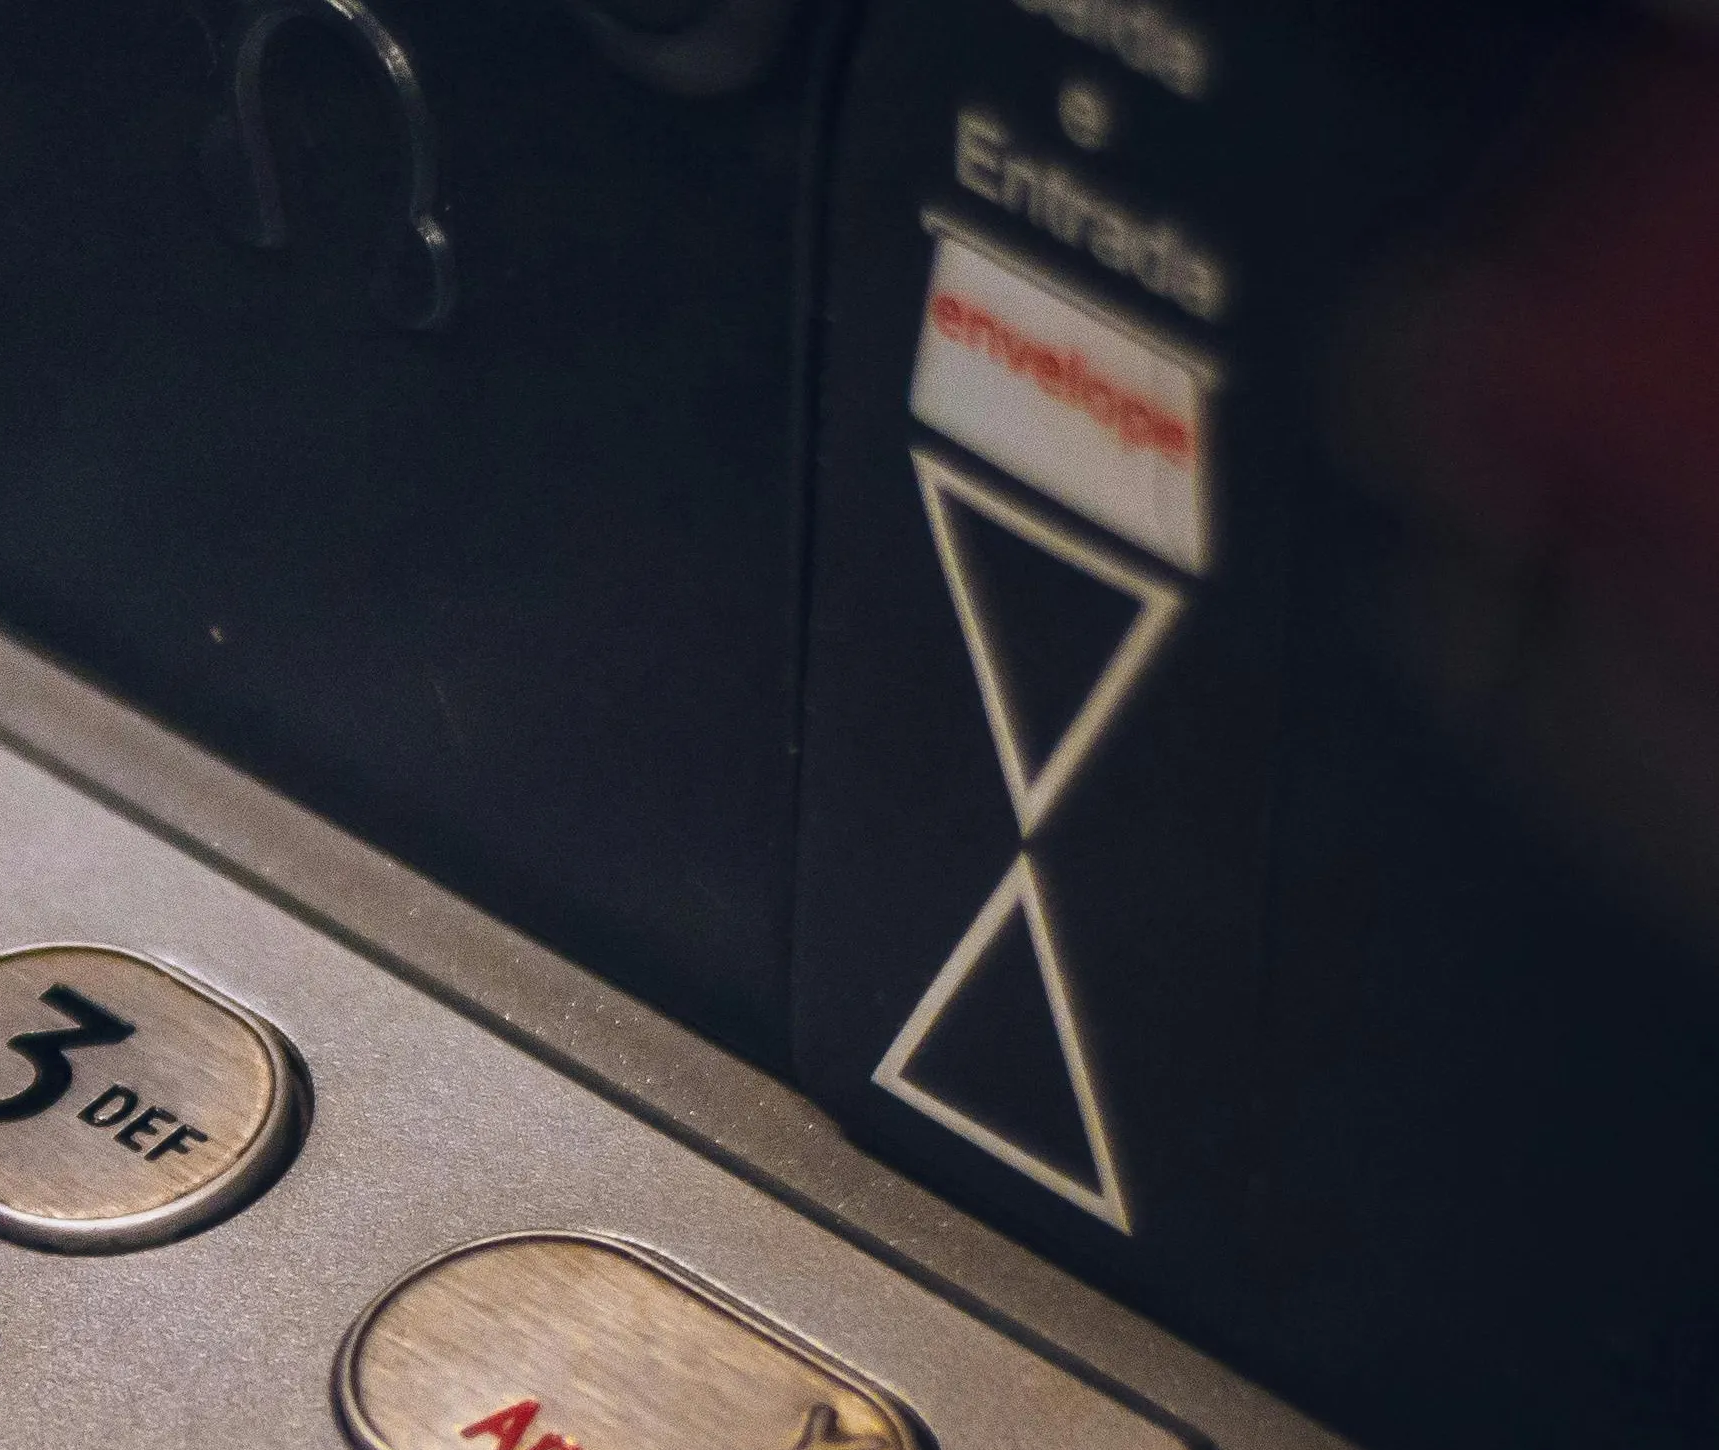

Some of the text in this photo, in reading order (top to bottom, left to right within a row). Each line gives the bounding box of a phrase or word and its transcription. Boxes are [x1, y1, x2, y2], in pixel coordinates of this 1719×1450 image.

[955, 108, 1225, 320] Entrada
[930, 290, 1195, 464] envelope
[75, 1082, 210, 1163] DEF
